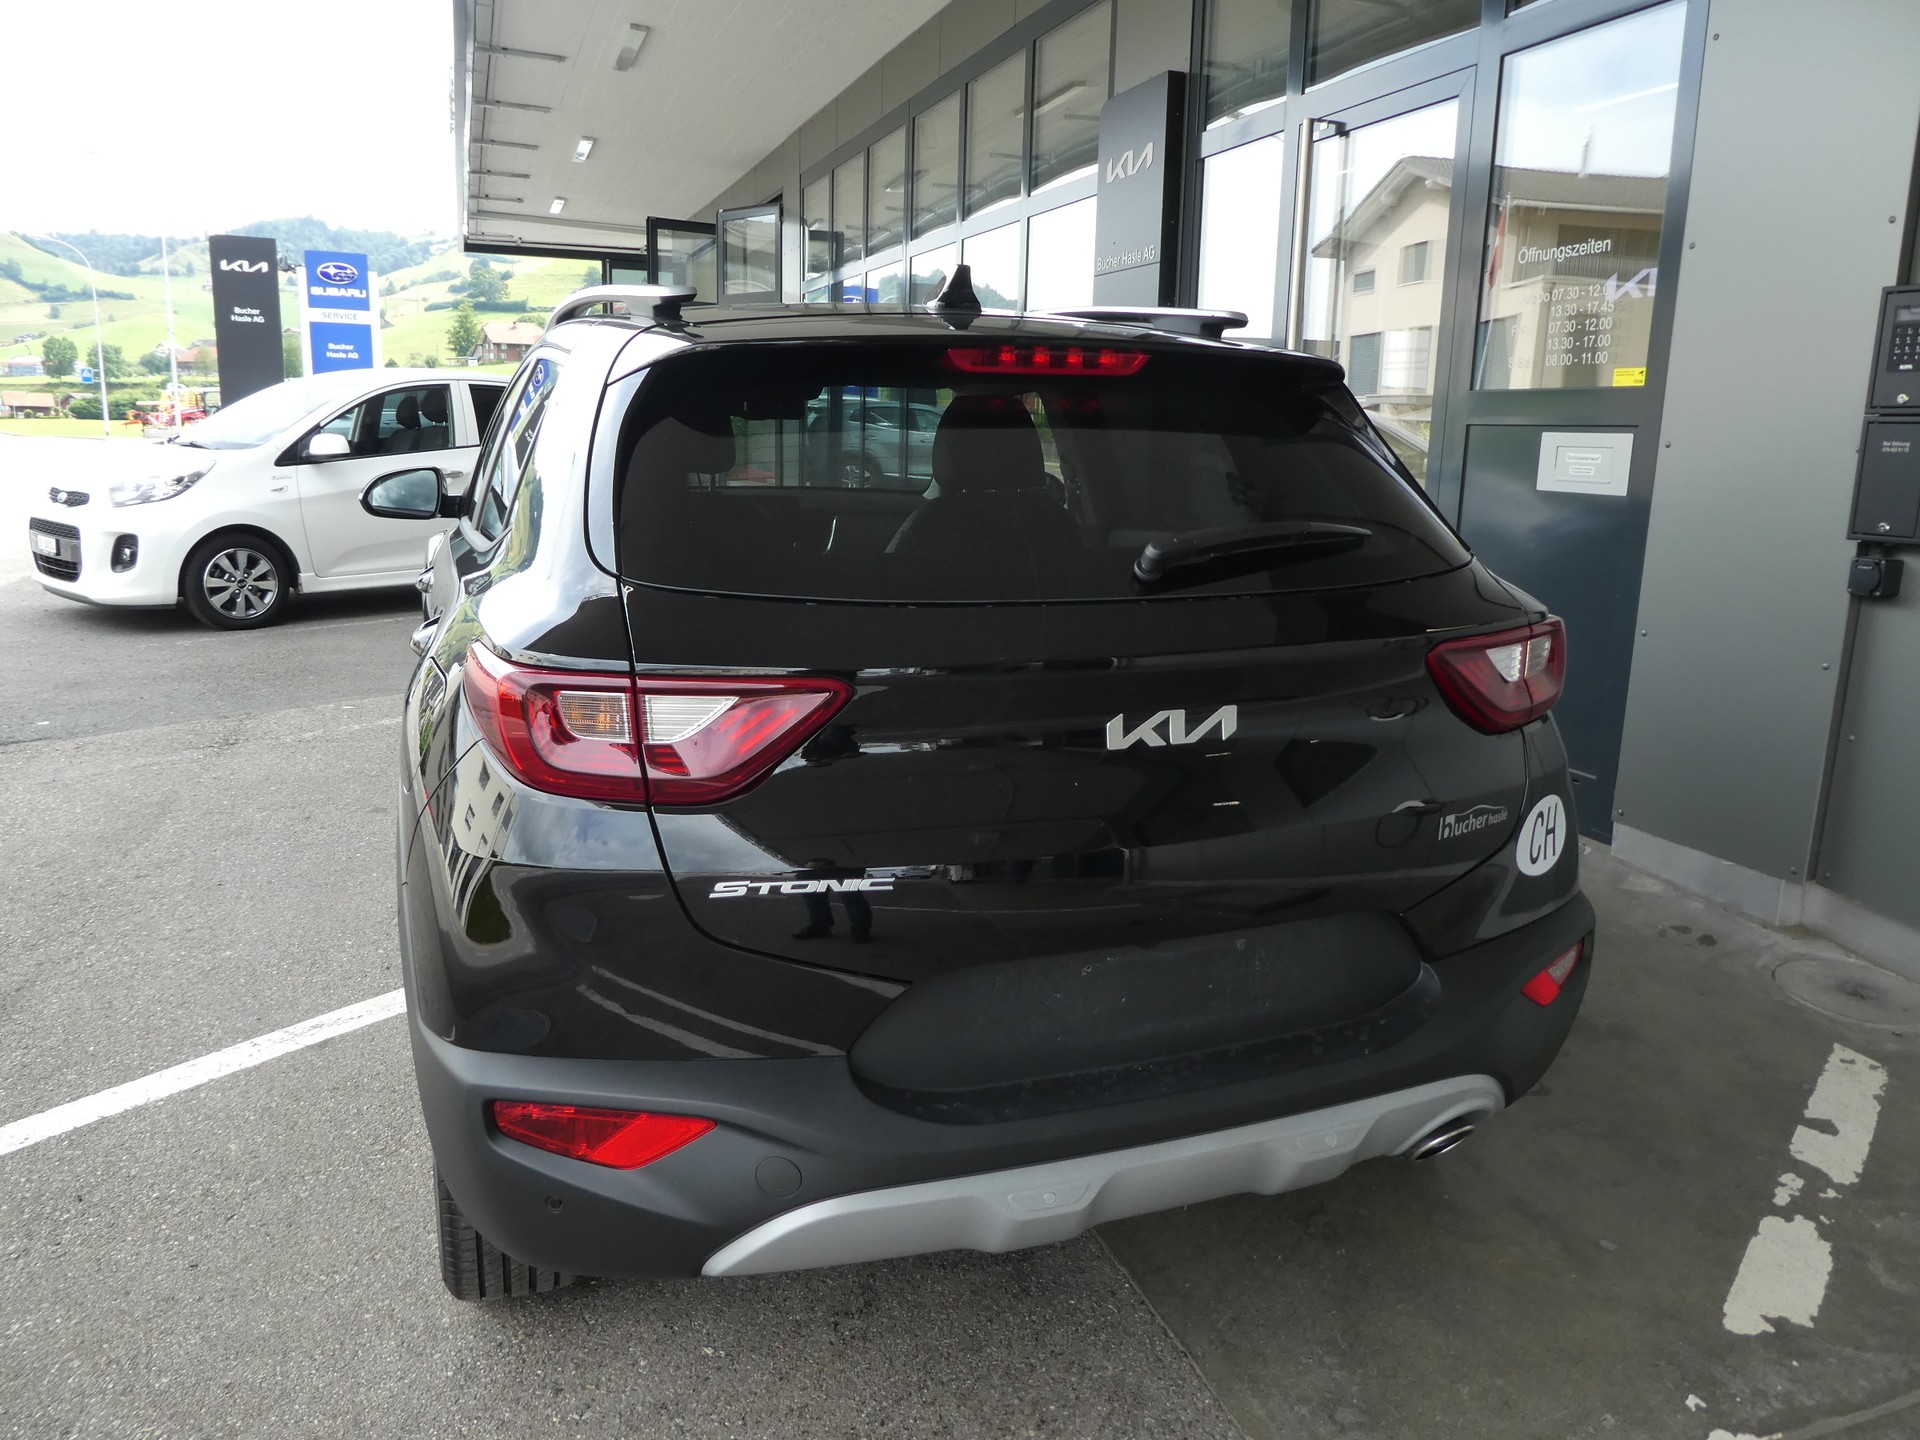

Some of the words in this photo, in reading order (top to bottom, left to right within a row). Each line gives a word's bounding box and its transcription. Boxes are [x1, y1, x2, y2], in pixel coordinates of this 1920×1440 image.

[1106, 141, 1154, 184] KIA
[1097, 255, 1121, 271] Bucher
[1121, 248, 1142, 266] Hasle
[1143, 245, 1155, 260] AG
[1518, 238, 1611, 265] Öffnungszeiten
[219, 259, 269, 273] KIA
[310, 286, 367, 298] SUBARU
[1551, 287, 1579, 301] 07.30
[1589, 284, 1611, 300] 12.0
[233, 306, 260, 315] Bucher
[321, 311, 358, 321] SERVICE
[1551, 304, 1577, 317] 13.30
[1587, 301, 1614, 315] 17.45
[231, 314, 252, 323] Hasle
[252, 315, 265, 323] AG
[1549, 320, 1575, 334] 07.30
[1585, 317, 1612, 331] 12.00
[328, 342, 354, 350] Bucher
[1547, 337, 1573, 350] 13.30
[1583, 334, 1610, 348] 17.00
[326, 351, 346, 359] Hasle
[1545, 353, 1572, 367] 08.00
[1581, 351, 1608, 365] 11.00
[1106, 704, 1238, 751] KIA
[1488, 809, 1508, 826] hasle
[1529, 802, 1558, 865] CH
[709, 878, 896, 899] STONIC
